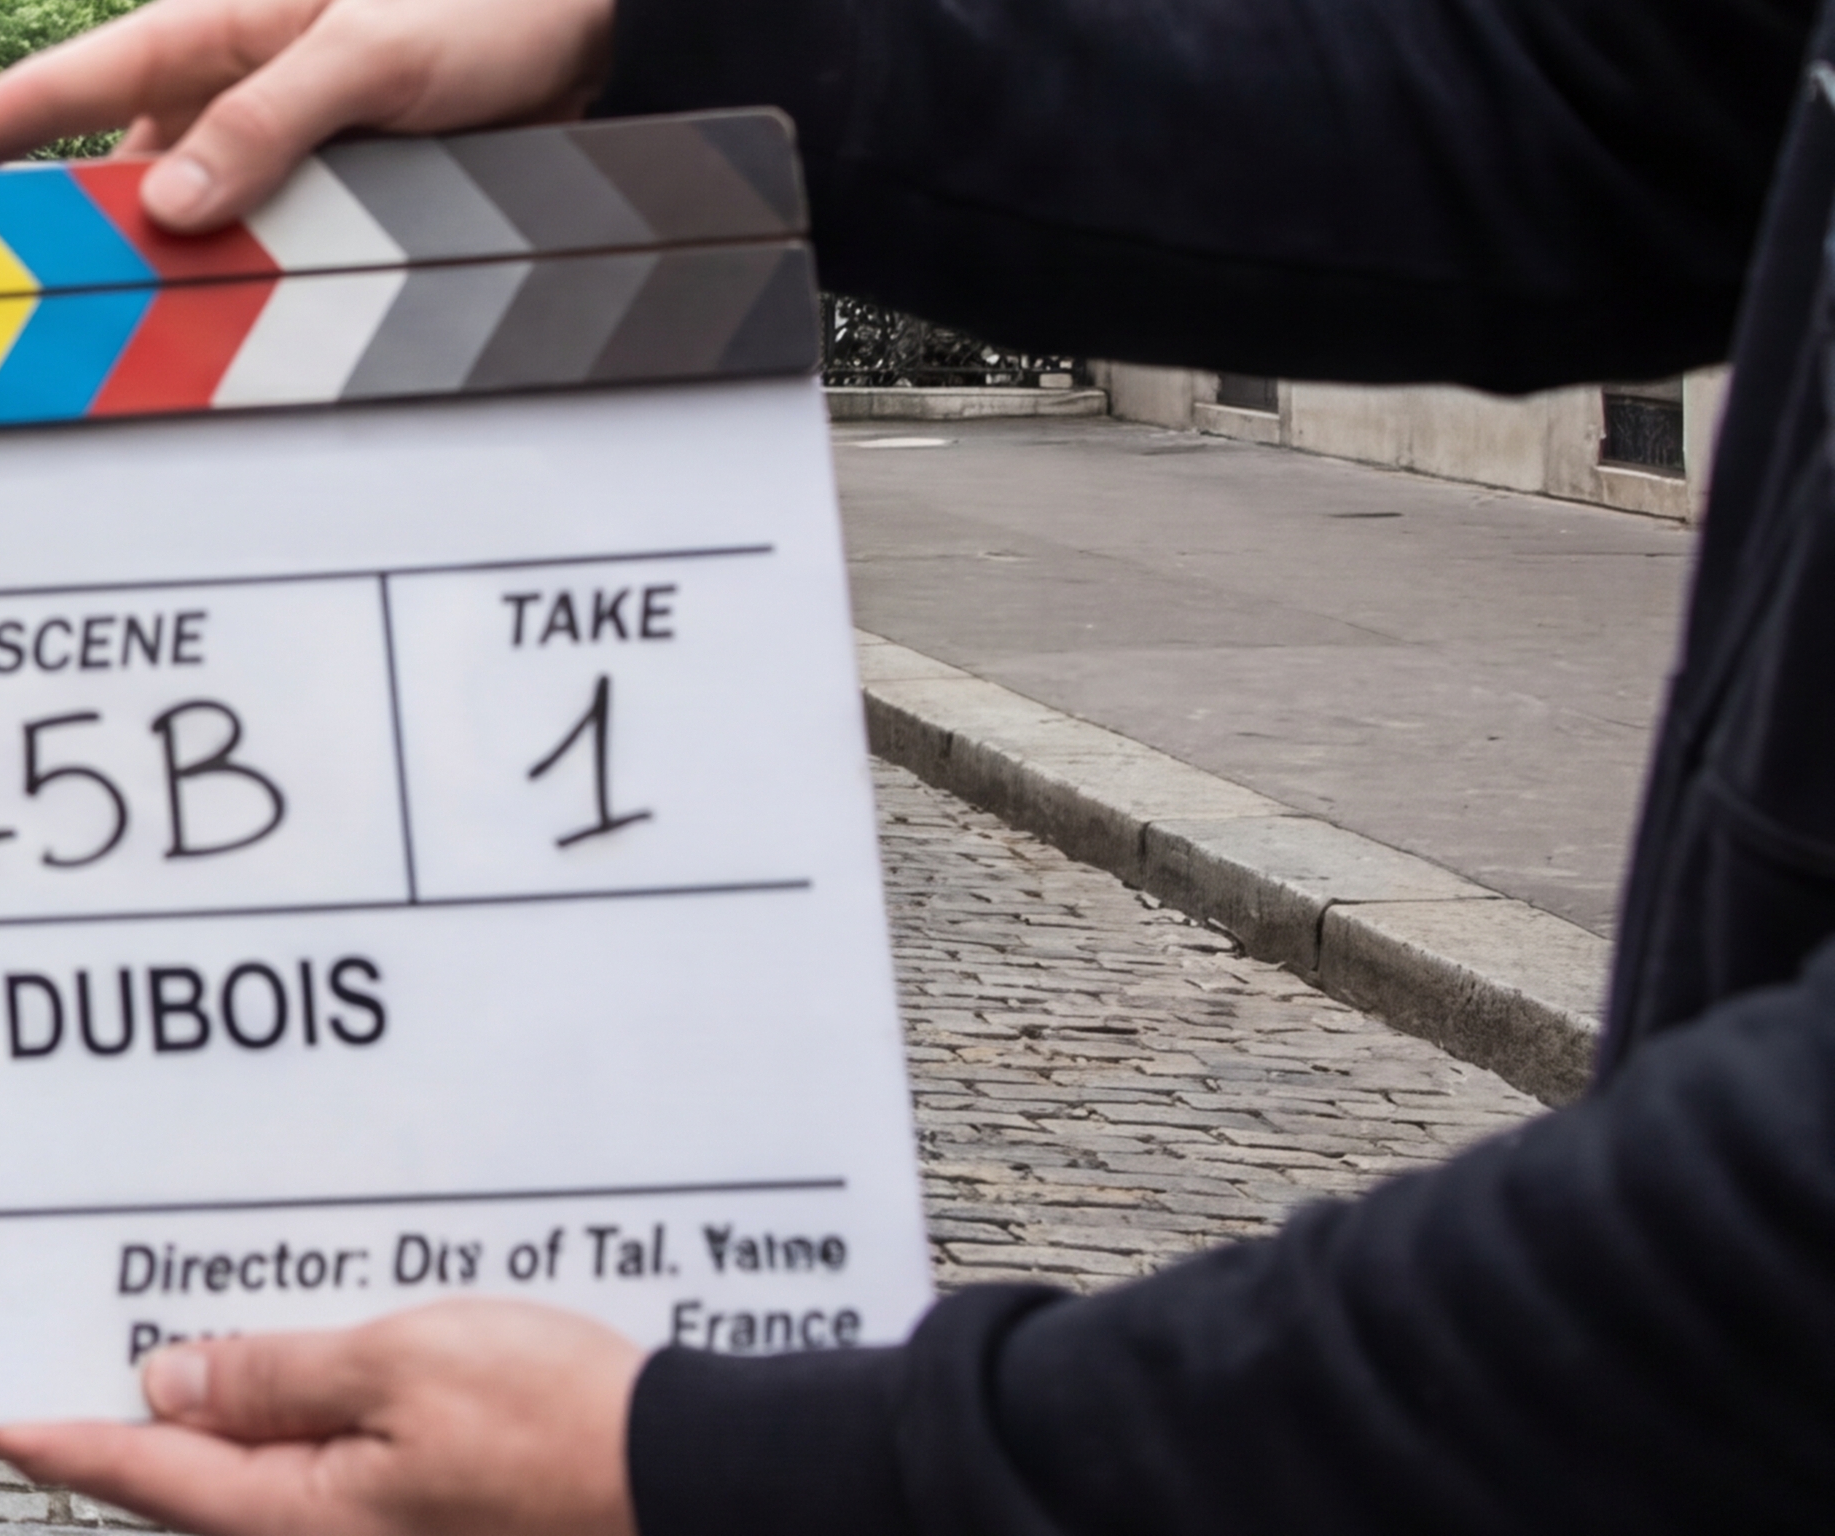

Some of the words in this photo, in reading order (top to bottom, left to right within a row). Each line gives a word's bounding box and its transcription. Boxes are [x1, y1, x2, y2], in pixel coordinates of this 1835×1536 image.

[501, 583, 678, 648] TAKE
[526, 673, 653, 850] 1
[4, 954, 389, 1062] DUBOIS
[117, 1242, 368, 1297] Director:
[506, 1227, 565, 1283] of
[584, 1222, 679, 1279] Tal.
[671, 1300, 863, 1350] France
